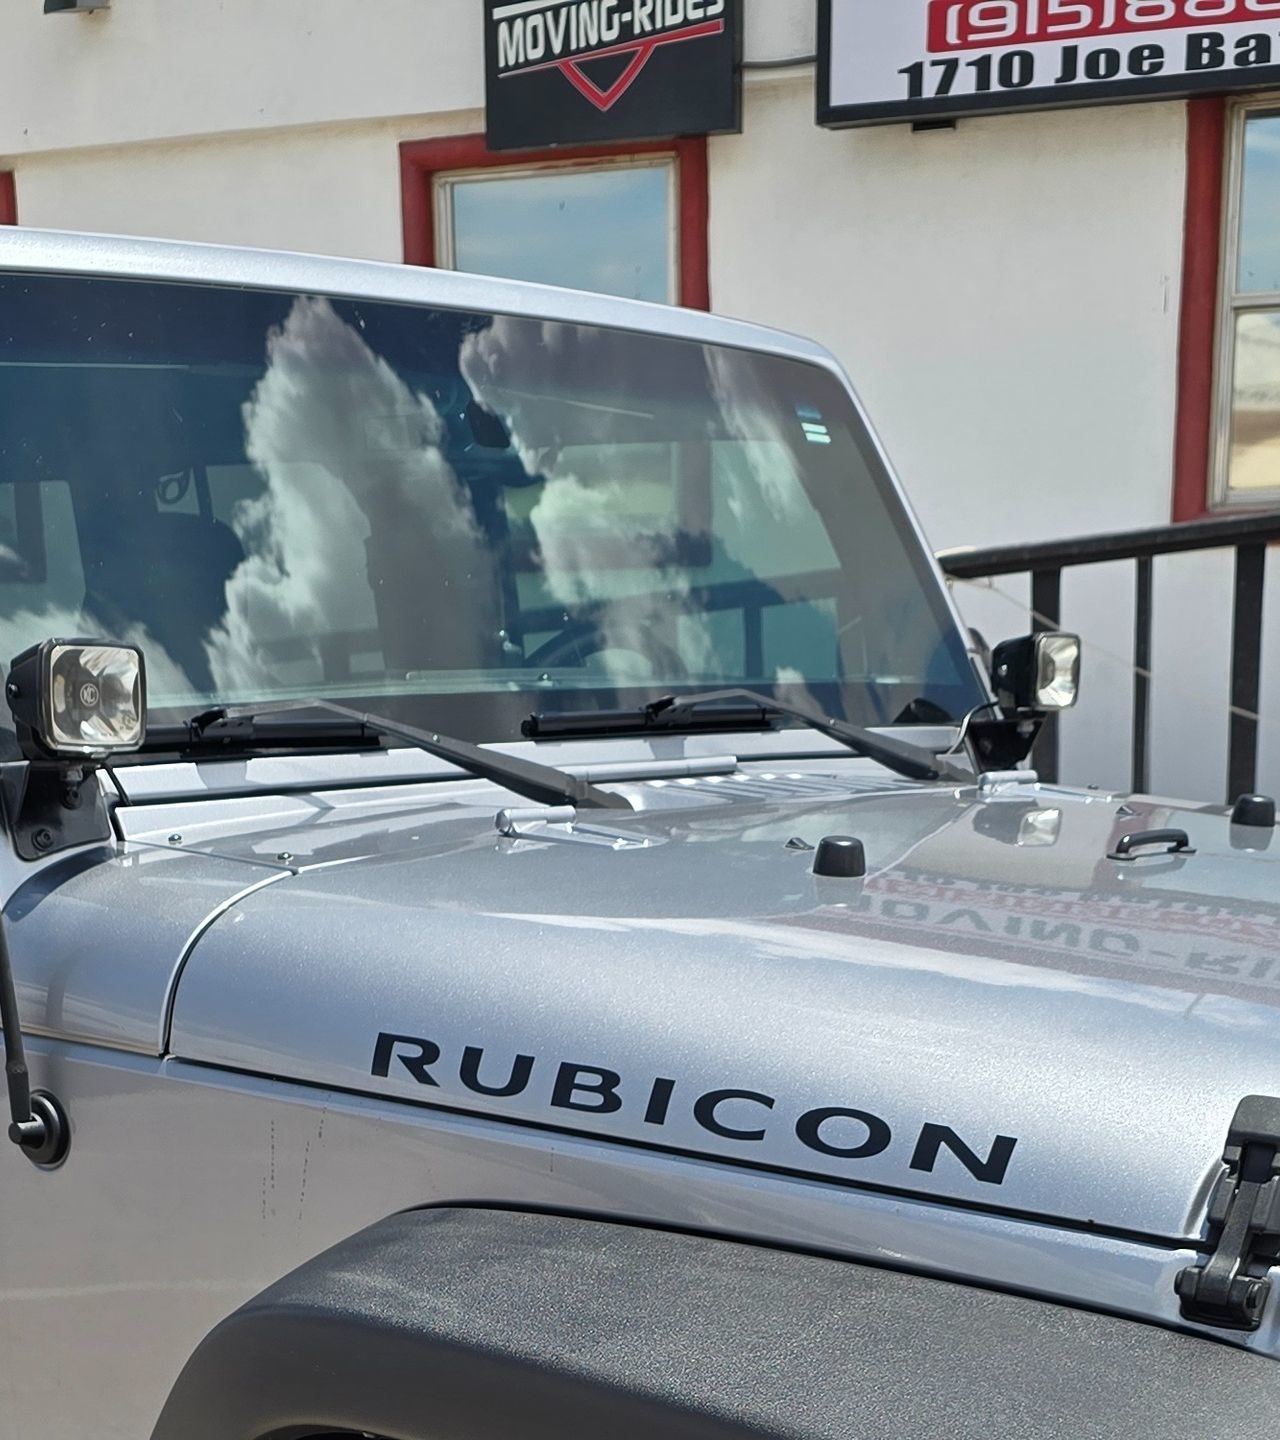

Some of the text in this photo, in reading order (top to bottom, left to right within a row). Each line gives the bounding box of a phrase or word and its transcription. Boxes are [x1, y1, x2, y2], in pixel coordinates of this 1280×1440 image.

[897, 50, 1035, 99] 1710
[1054, 44, 1165, 84] Joe
[370, 1032, 1018, 1185] RUBICON
